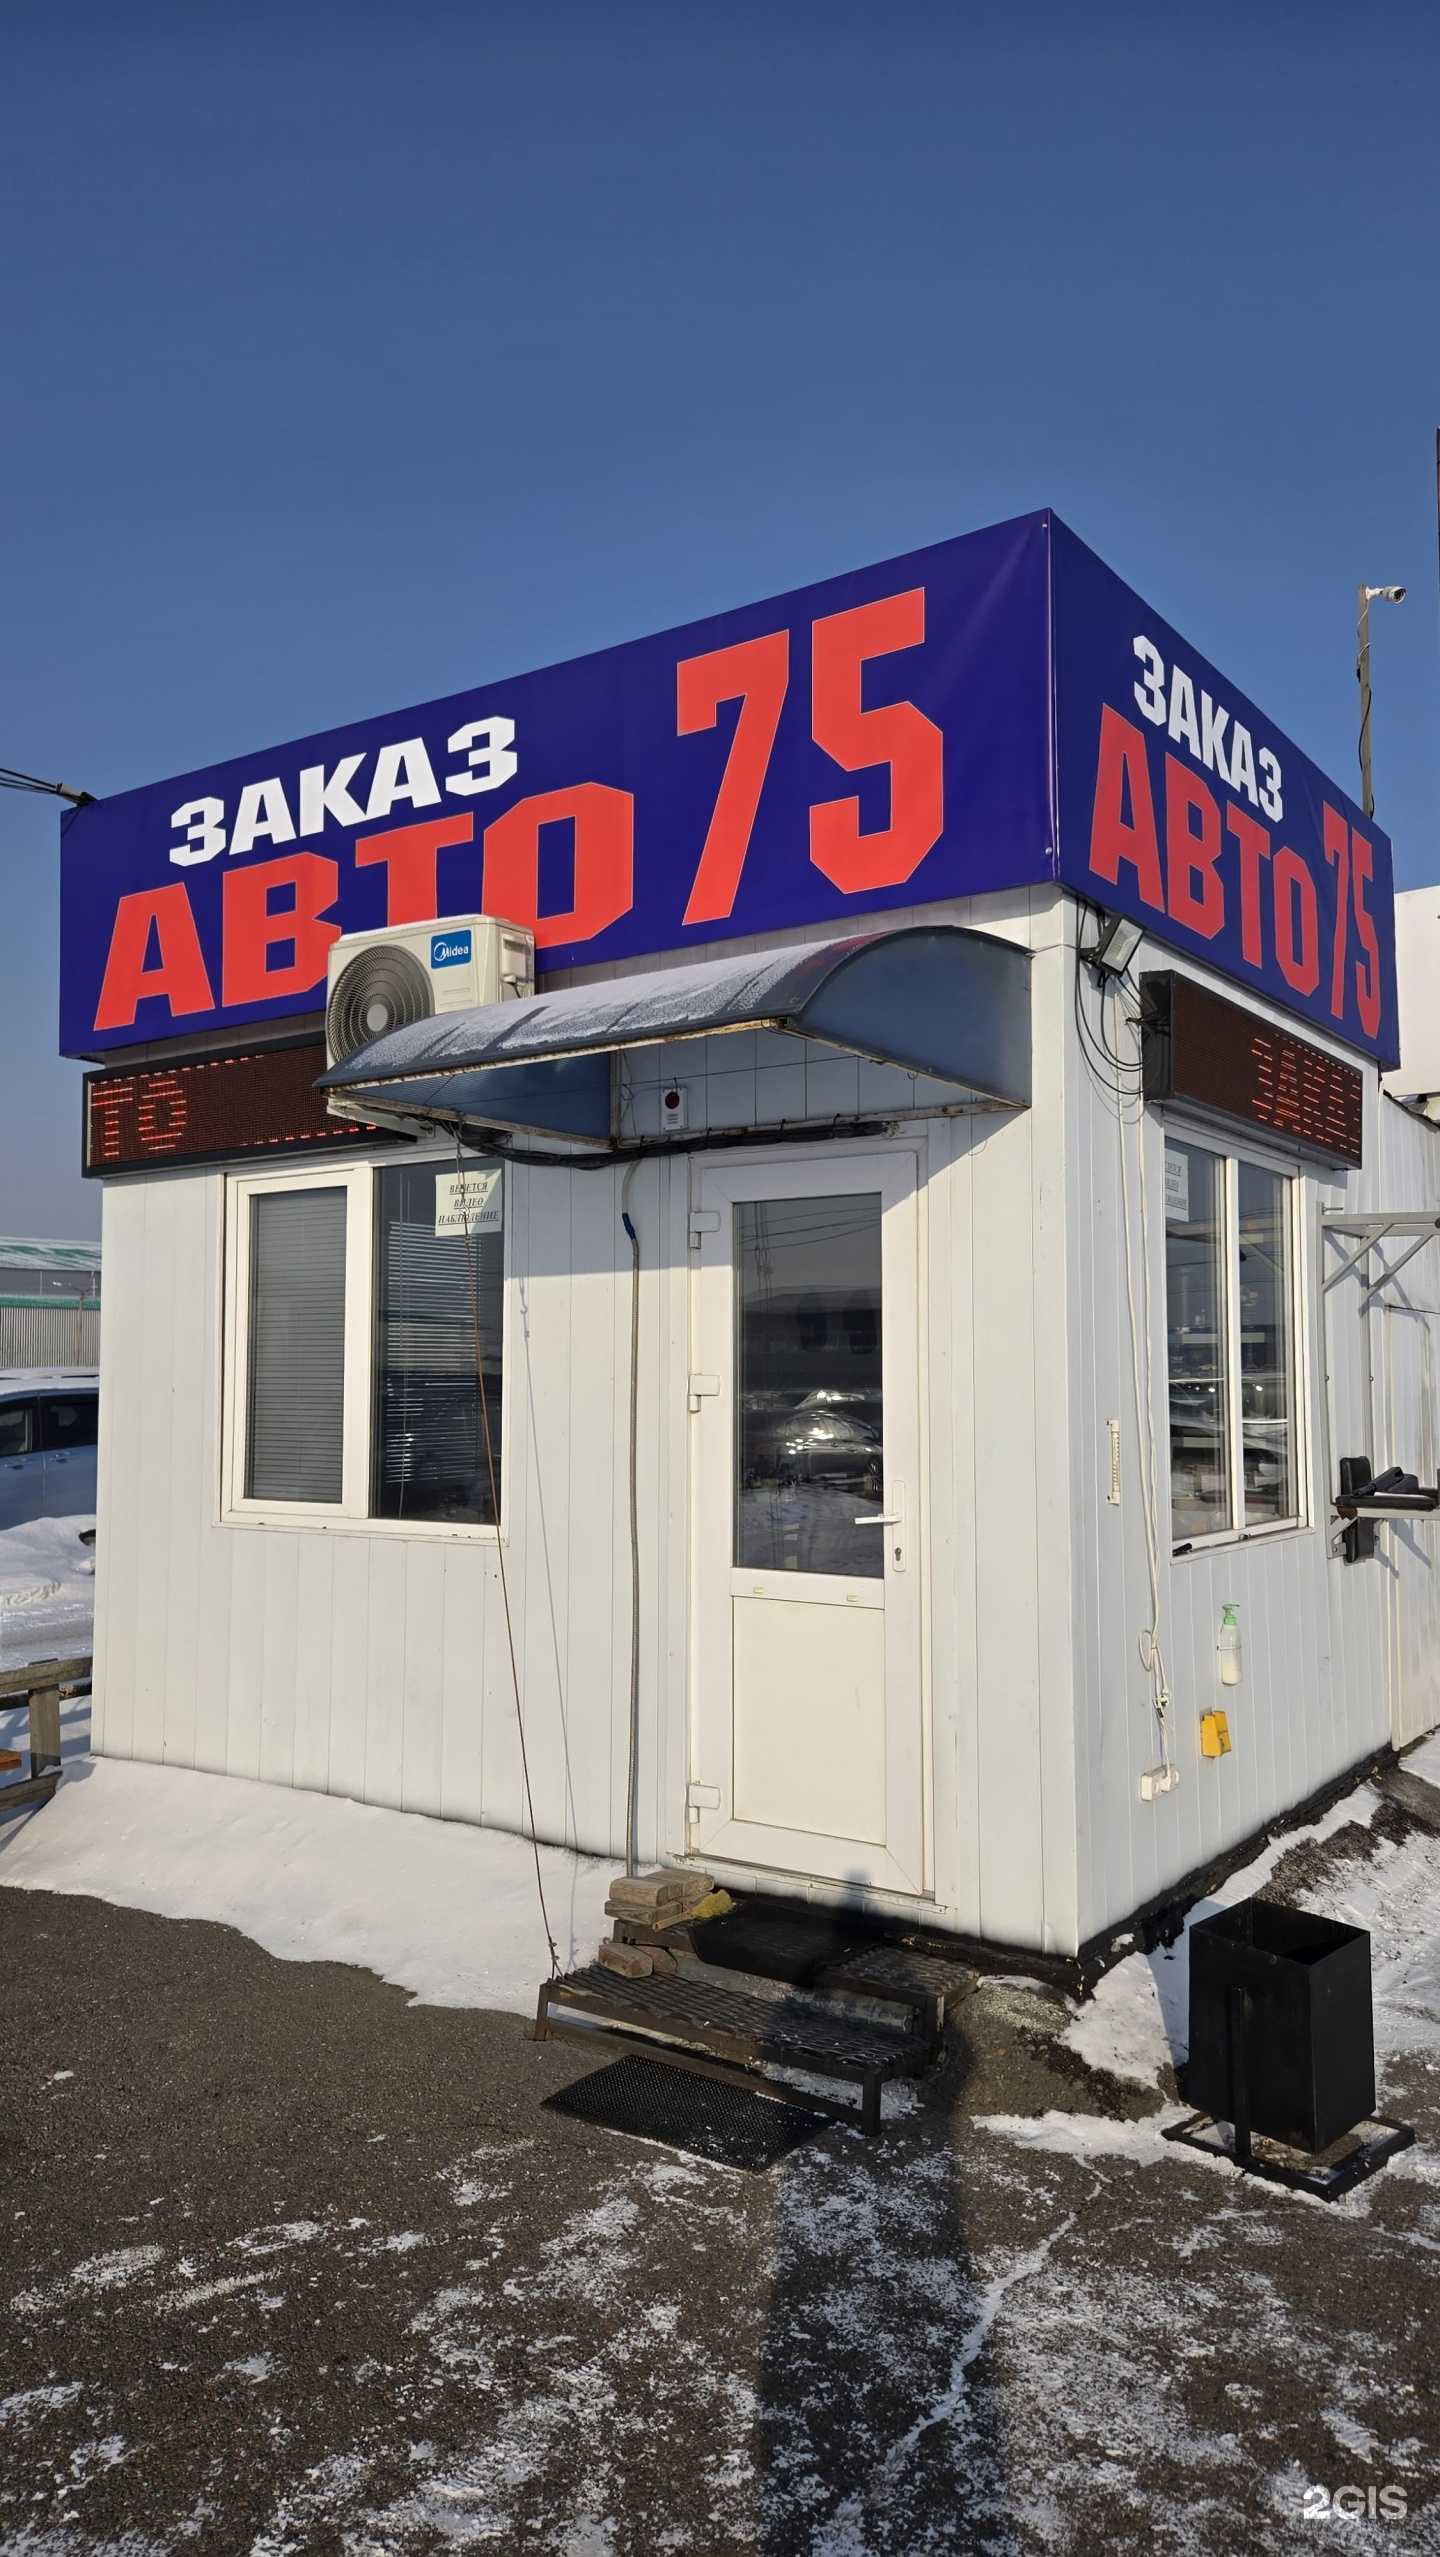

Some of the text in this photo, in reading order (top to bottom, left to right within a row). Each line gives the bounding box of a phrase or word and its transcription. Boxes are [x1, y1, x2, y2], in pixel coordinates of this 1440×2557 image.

[94, 588, 944, 1031] АВТО 75
[168, 715, 519, 868] ЗАКАЗ
[1132, 634, 1284, 824] ЗАКАЗ
[434, 942, 470, 962] Midea
[1089, 705, 1381, 1040] АВТО 75
